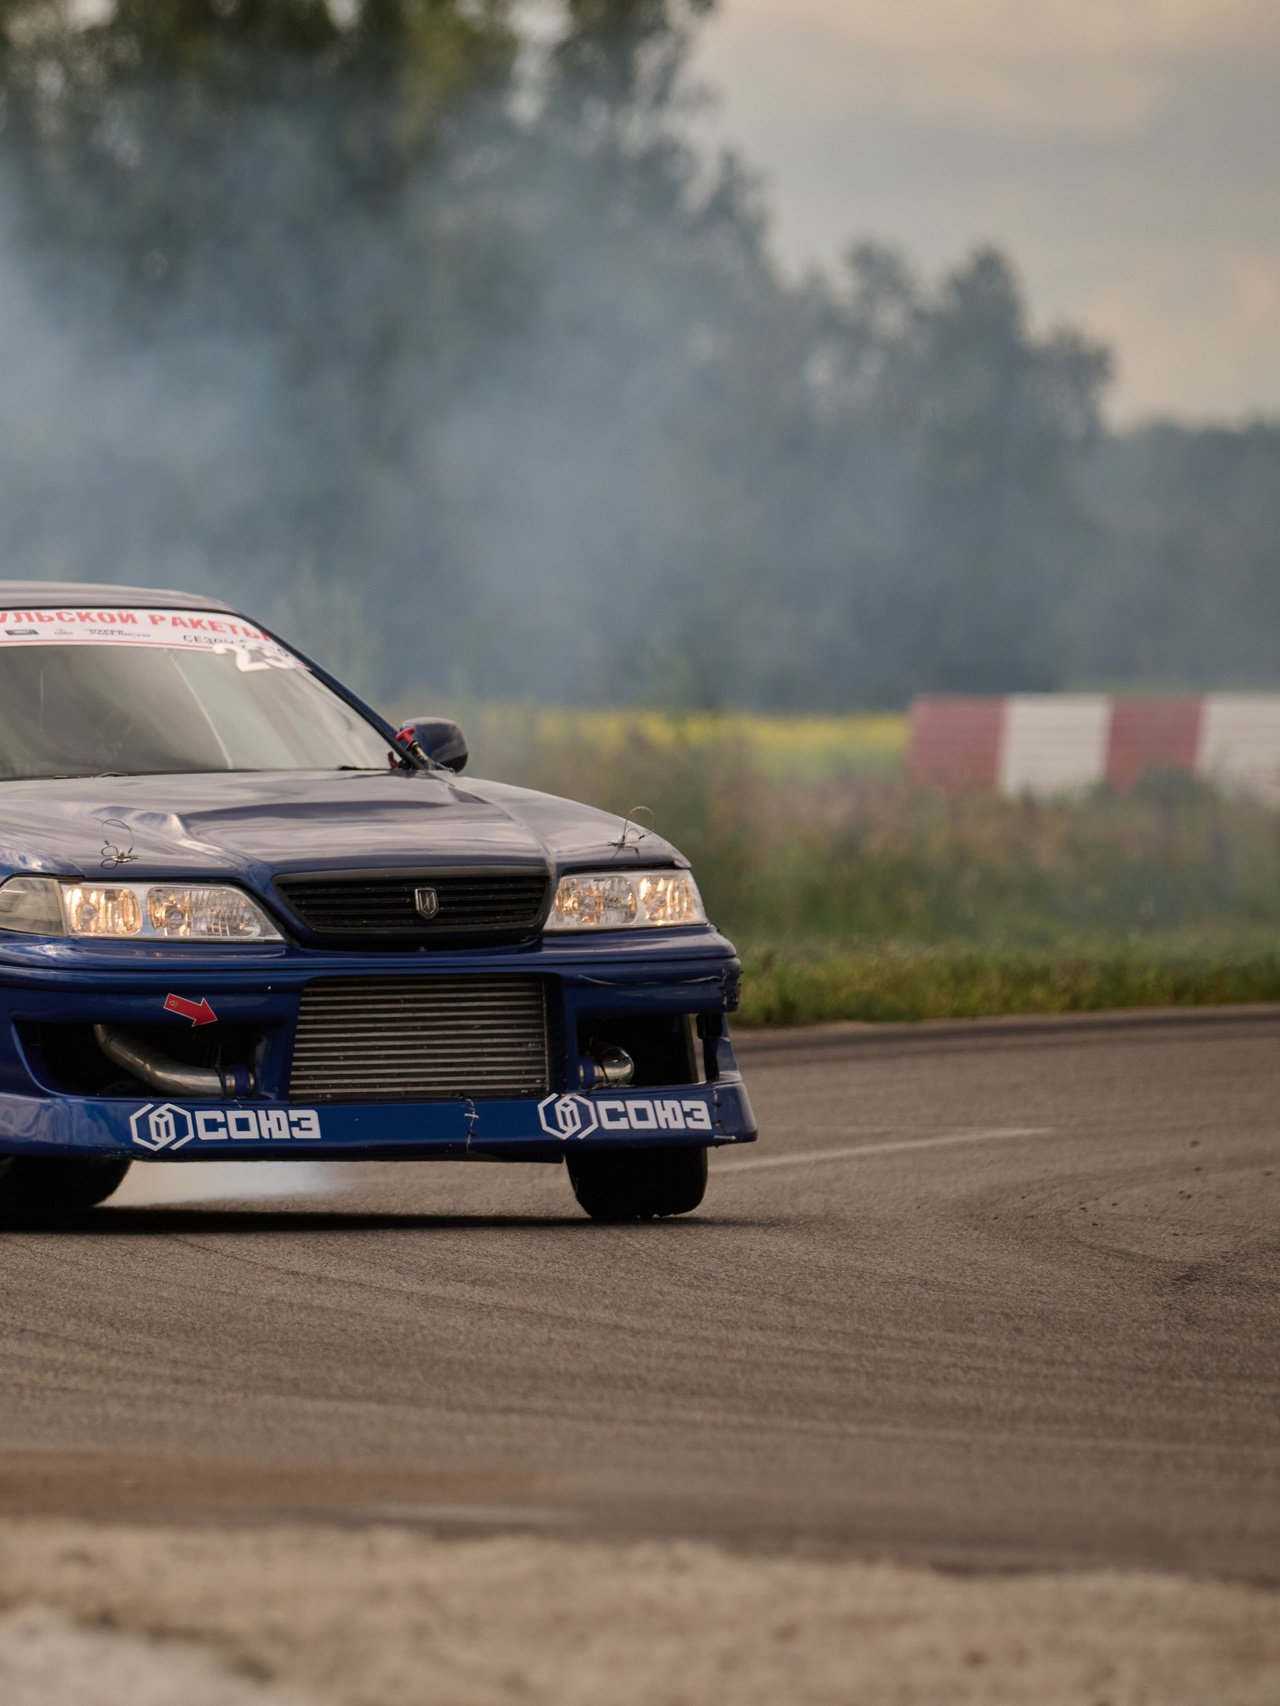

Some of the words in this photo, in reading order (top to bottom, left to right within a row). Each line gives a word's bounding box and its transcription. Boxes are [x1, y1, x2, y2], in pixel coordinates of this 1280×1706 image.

[147, 613, 270, 642] РАКЕТЫ
[194, 1108, 322, 1140] СОЮЗ
[598, 1099, 713, 1131] СОЮЗ
